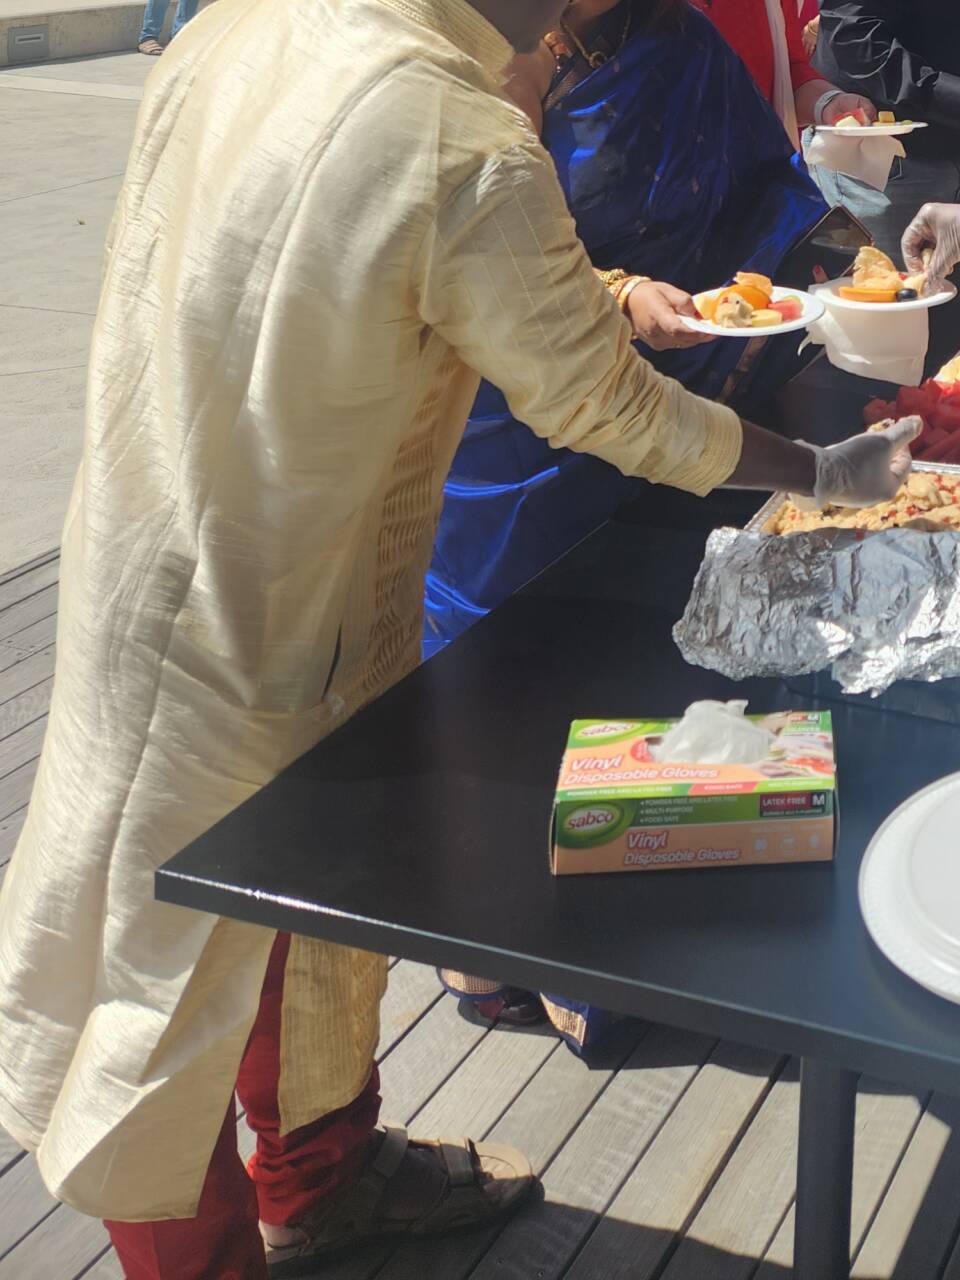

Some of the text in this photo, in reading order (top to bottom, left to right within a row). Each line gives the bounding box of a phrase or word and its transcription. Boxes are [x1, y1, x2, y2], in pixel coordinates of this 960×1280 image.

[581, 722, 635, 737] sabco
[571, 755, 624, 771] Vinyl
[564, 766, 719, 786] Disposable Gloves
[762, 793, 825, 807] LATEX FREE M
[567, 808, 615, 831] sabco
[628, 830, 669, 850] Vinyl
[623, 847, 741, 867] Disposable Gloves
